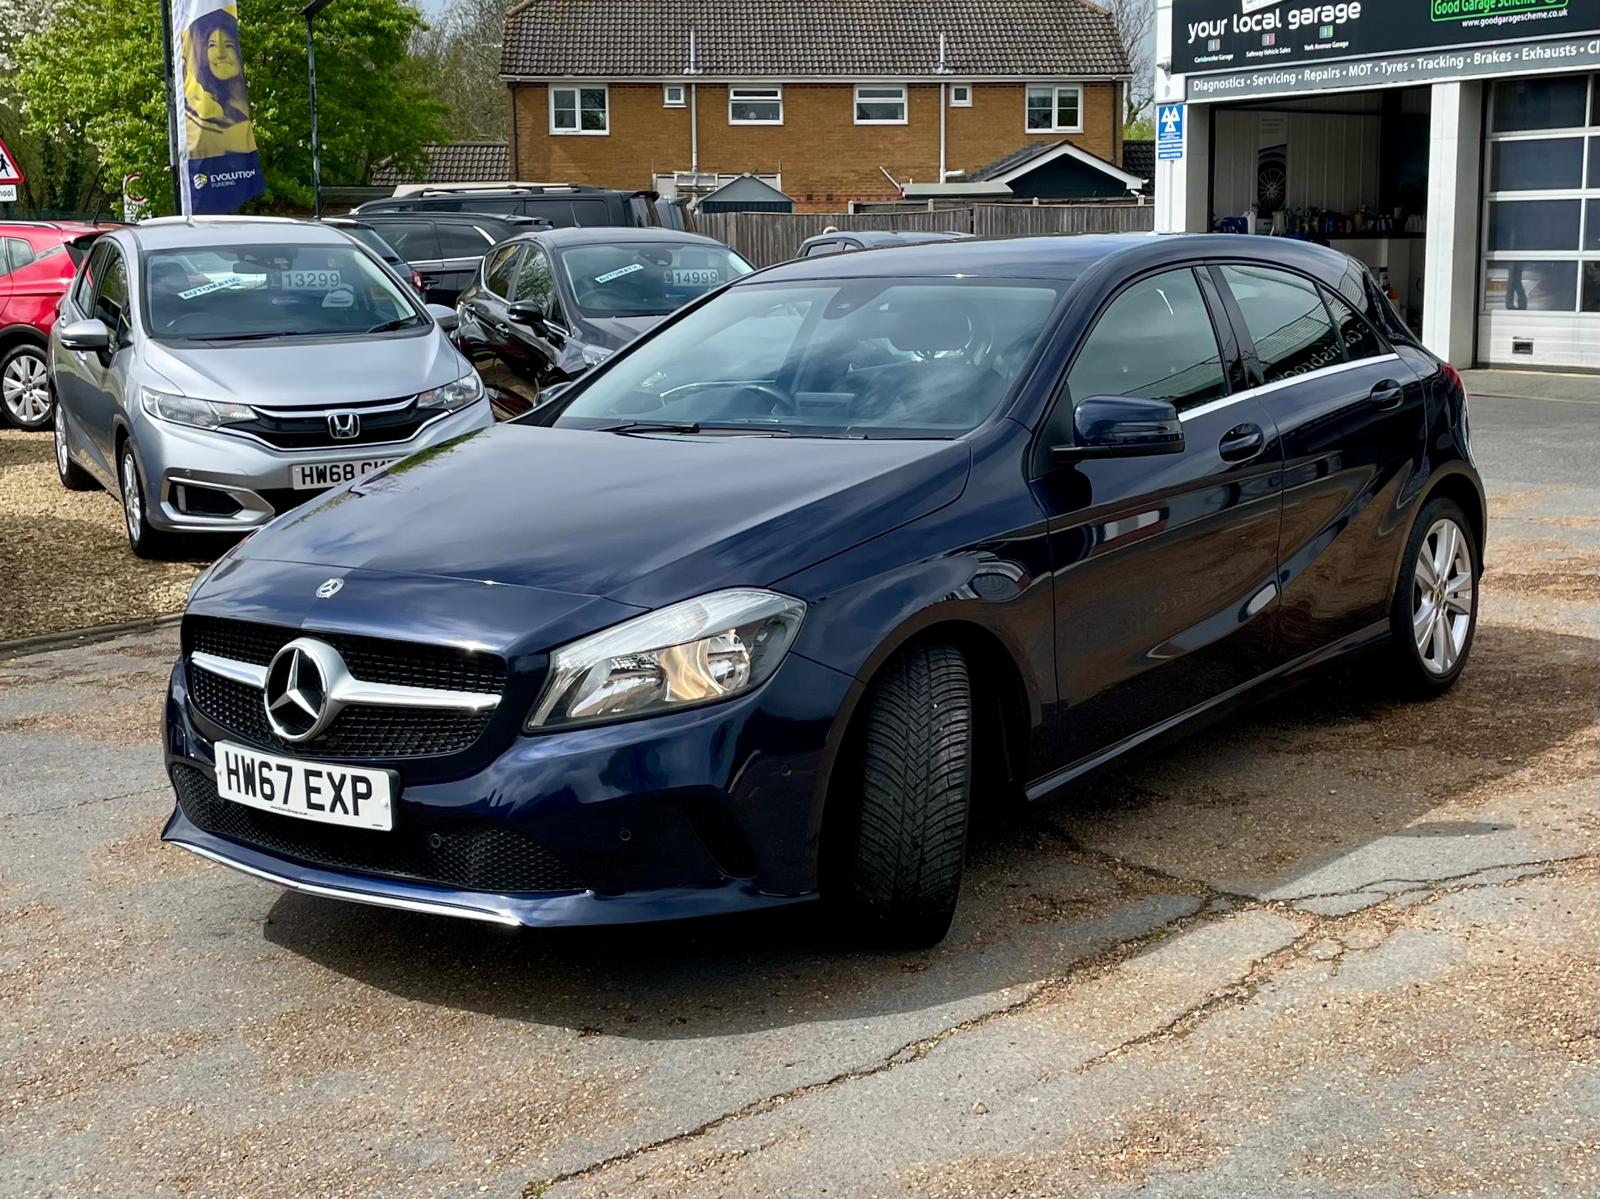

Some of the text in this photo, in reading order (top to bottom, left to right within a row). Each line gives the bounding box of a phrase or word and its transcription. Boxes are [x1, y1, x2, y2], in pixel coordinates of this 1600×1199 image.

[1435, 0, 1460, 15] Good
[1462, 0, 1496, 13] Garage
[1462, 8, 1568, 27] www.goodgaragescheme.co.uk
[1188, 2, 1361, 43] your local garage
[1193, 76, 1245, 92] Diagnostics
[1252, 72, 1296, 87] Servicing
[1304, 66, 1340, 82] Repairs
[1349, 63, 1372, 77] MOT
[1380, 61, 1408, 76] Tyres
[1417, 56, 1464, 71] Tracking
[1474, 50, 1512, 65] Brakes
[1522, 44, 1577, 60] Exhausts
[210, 168, 256, 183] EVOLUTION
[183, 277, 241, 298] AUTOMATIC
[301, 463, 356, 486] HW68
[225, 751, 373, 817] HW67 EXP
